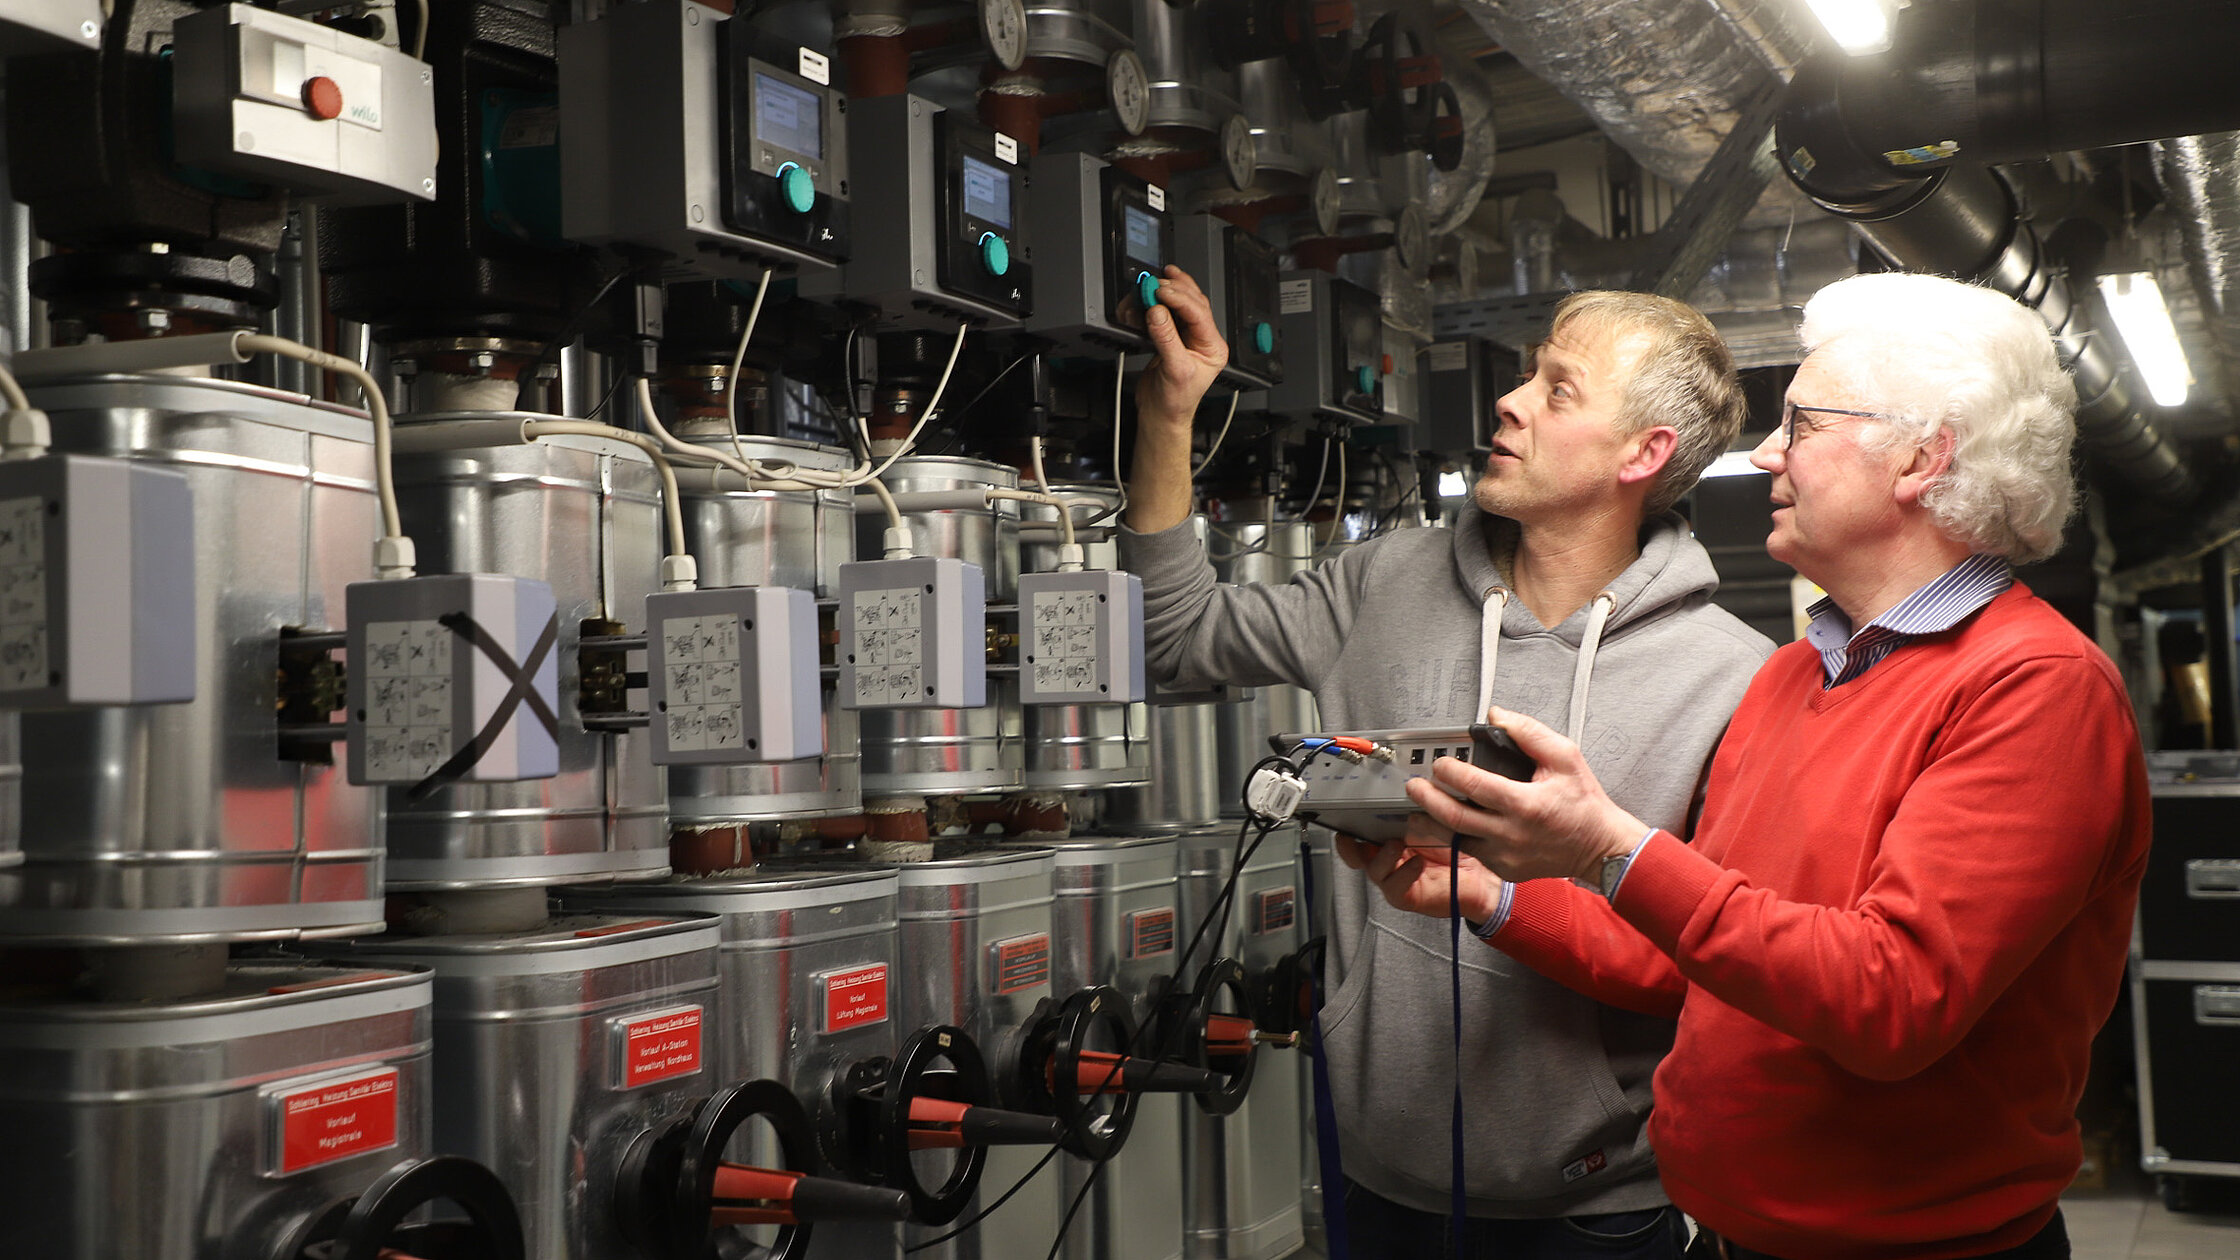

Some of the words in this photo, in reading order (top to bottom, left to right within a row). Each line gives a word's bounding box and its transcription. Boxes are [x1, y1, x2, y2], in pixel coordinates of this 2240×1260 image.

[351, 105, 378, 123] wilo
[640, 1044, 660, 1057] Vorlauf
[327, 1112, 357, 1129] Vorlauf
[319, 1131, 362, 1149] Magistrale
